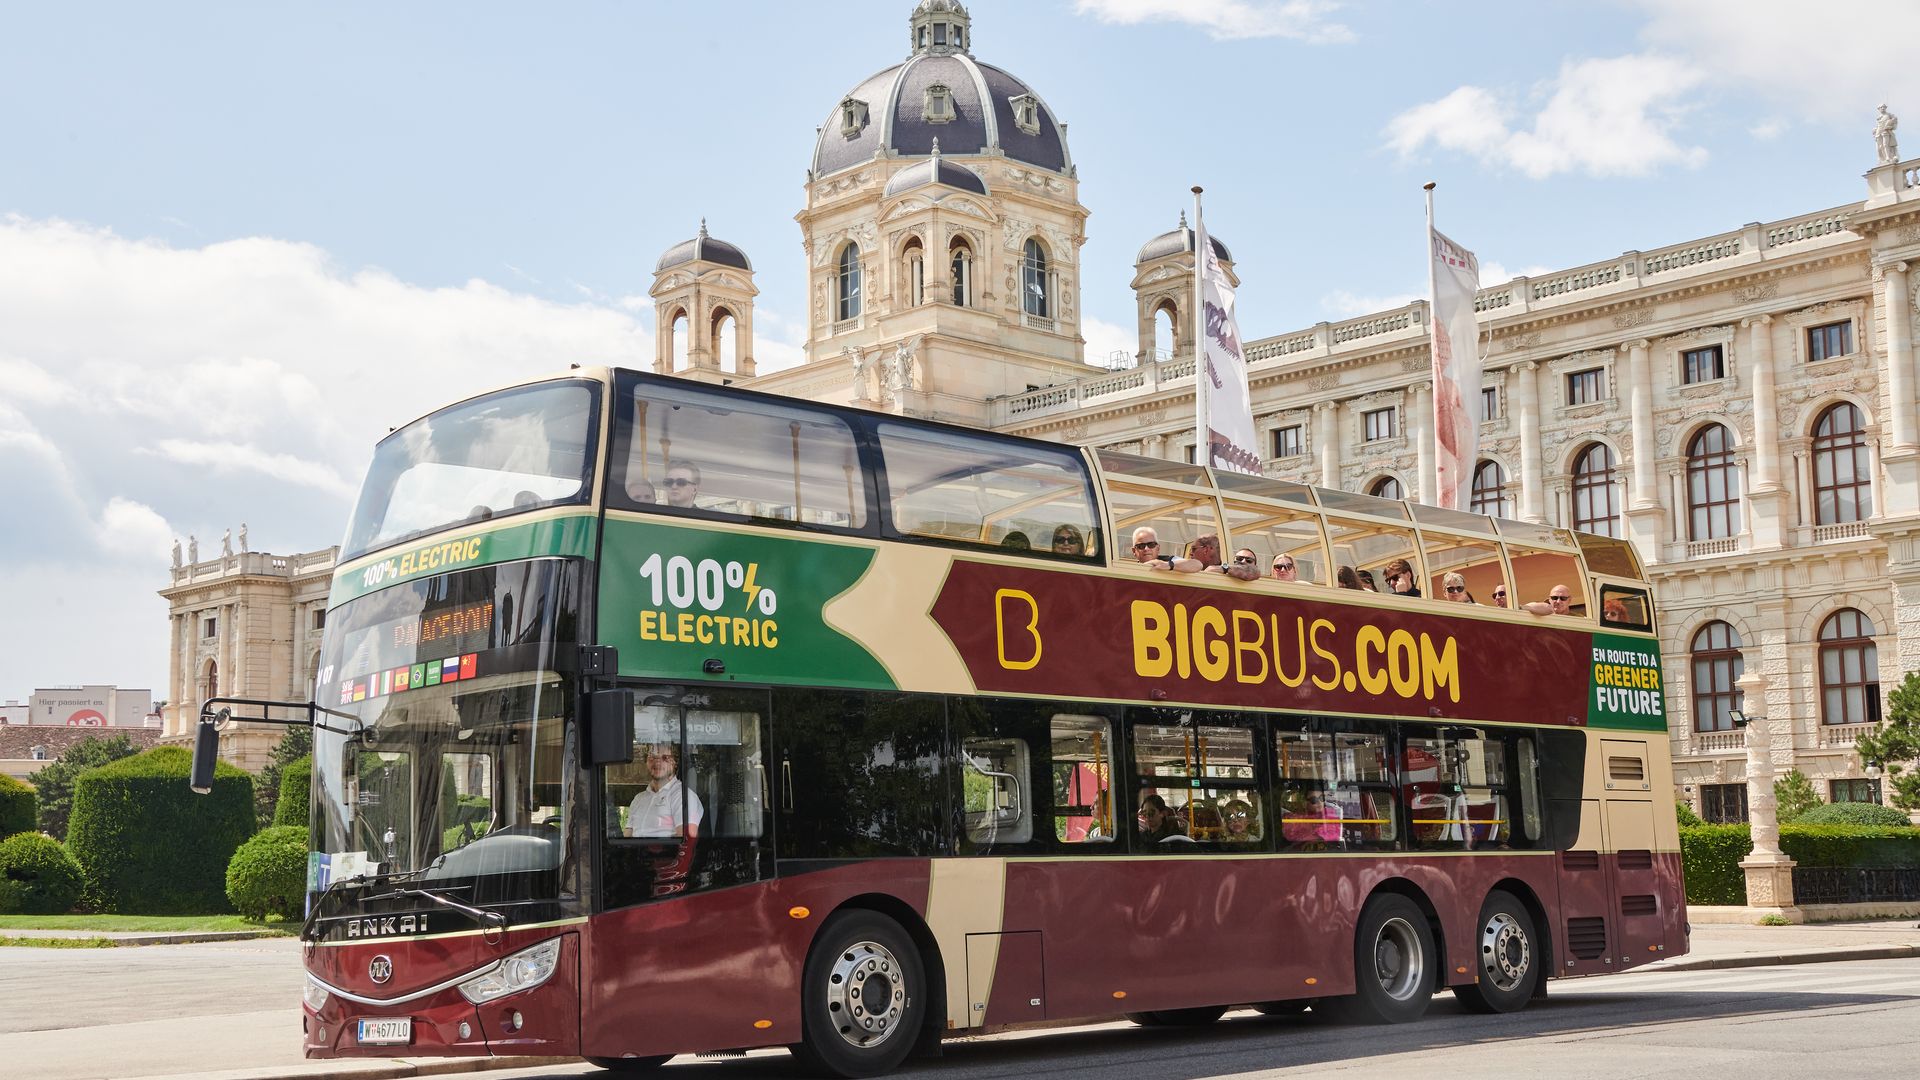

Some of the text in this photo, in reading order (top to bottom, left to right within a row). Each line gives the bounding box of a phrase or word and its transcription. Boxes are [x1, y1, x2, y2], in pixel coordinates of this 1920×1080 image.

[363, 537, 481, 588] 100% ELECTRIC
[639, 553, 777, 616] 100%
[640, 610, 778, 648] ELECTRIC
[995, 588, 1043, 671] B
[1130, 600, 1461, 703] BIGBUS.COM
[1592, 647, 1657, 667] EN ROUTE TO A
[1594, 663, 1659, 690] GREENER
[1596, 686, 1662, 716] FUTURE
[347, 914, 428, 938] ANKAI
